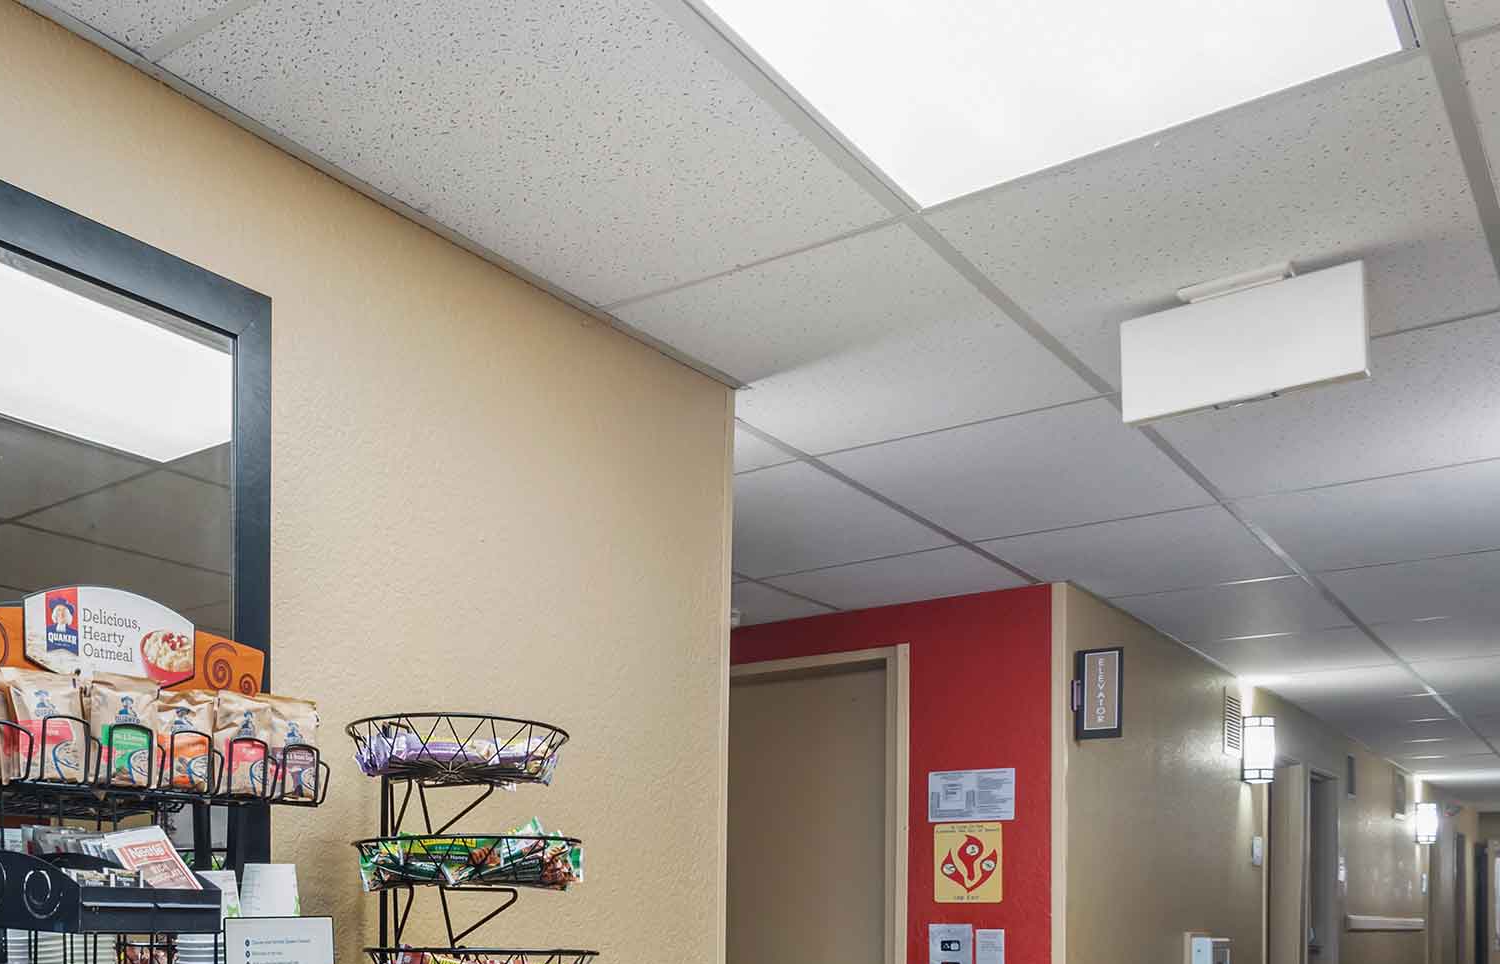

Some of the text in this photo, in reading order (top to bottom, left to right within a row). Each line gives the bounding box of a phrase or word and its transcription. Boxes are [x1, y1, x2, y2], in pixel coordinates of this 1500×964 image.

[82, 607, 141, 632] Delicious,
[47, 631, 77, 645] QUAKER
[83, 626, 125, 647] Hearty
[83, 642, 133, 663] Oatmeal
